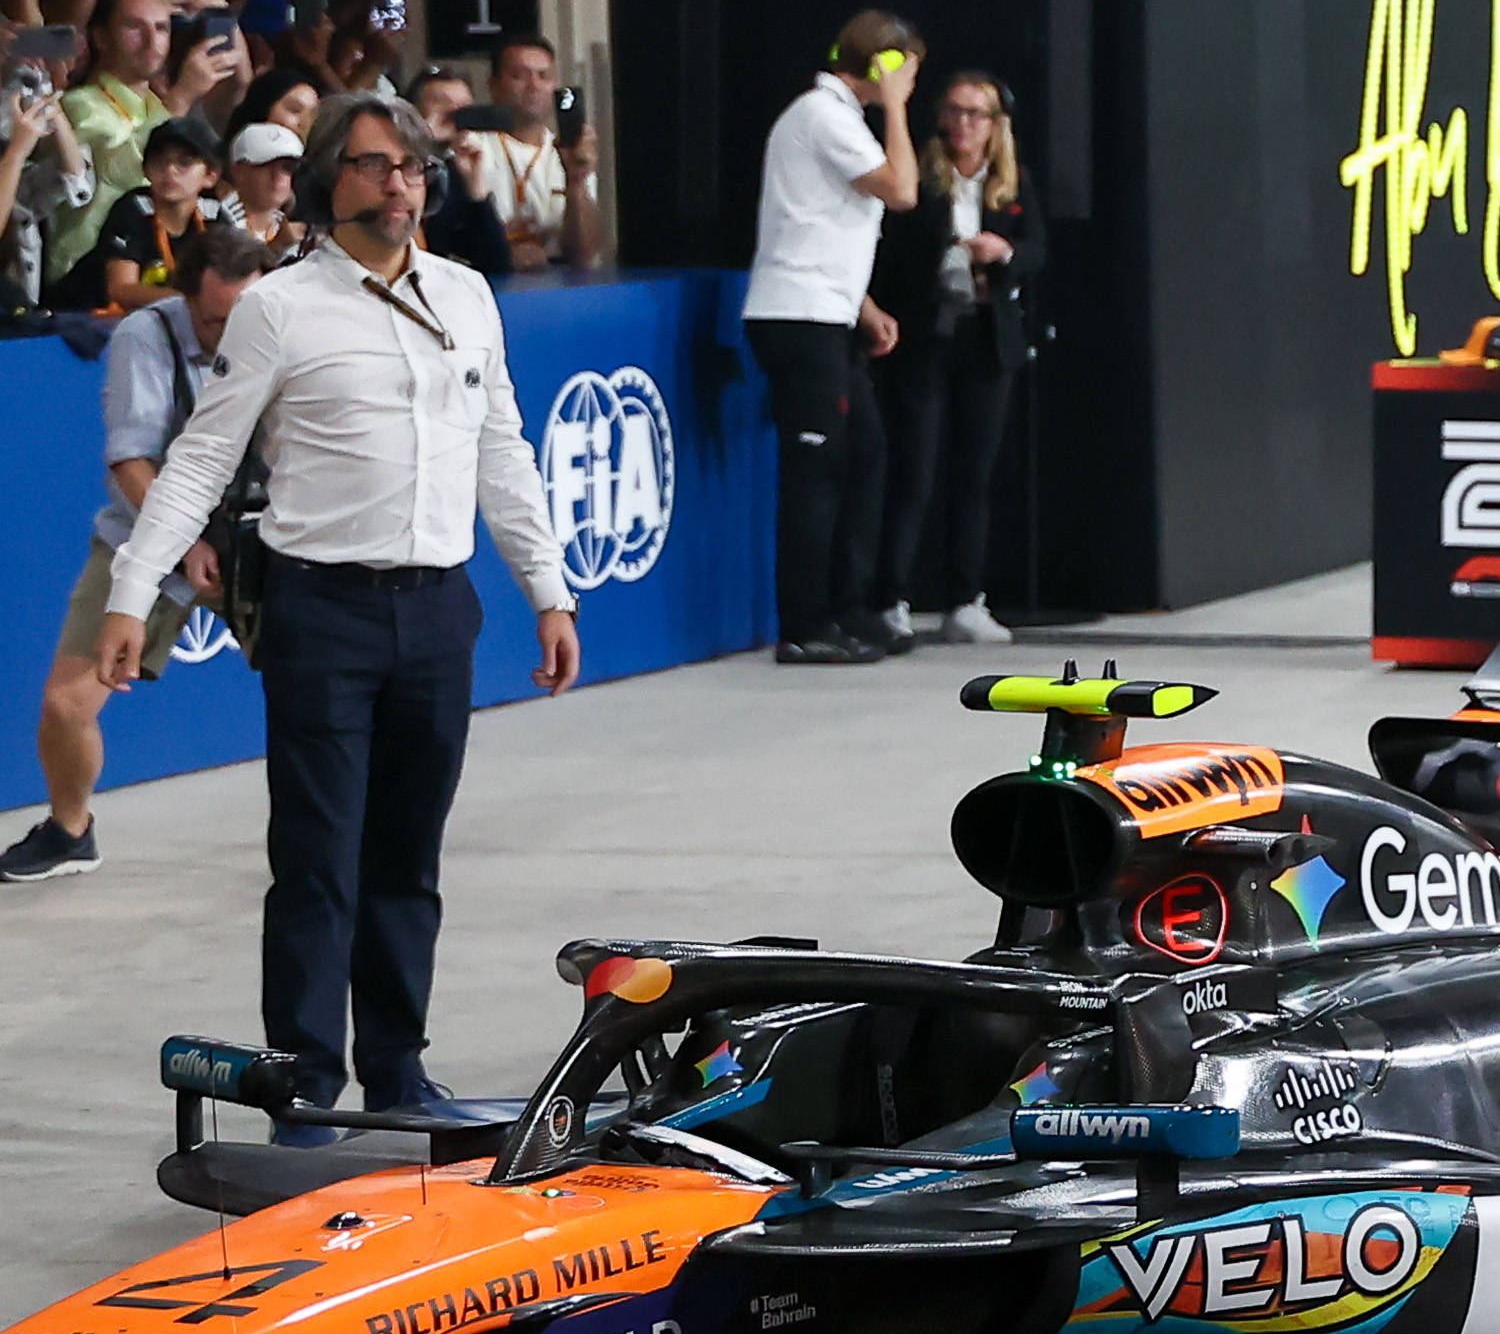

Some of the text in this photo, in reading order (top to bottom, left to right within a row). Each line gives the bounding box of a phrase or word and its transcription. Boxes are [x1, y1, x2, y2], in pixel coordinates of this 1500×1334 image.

[1112, 747, 1283, 817] allwyn
[1059, 994, 1109, 1009] MOUNTAIN
[1182, 978, 1228, 1014] okta
[1034, 1107, 1150, 1142] allwyn
[554, 1228, 670, 1299] MILLE
[1109, 1201, 1421, 1322] VELO
